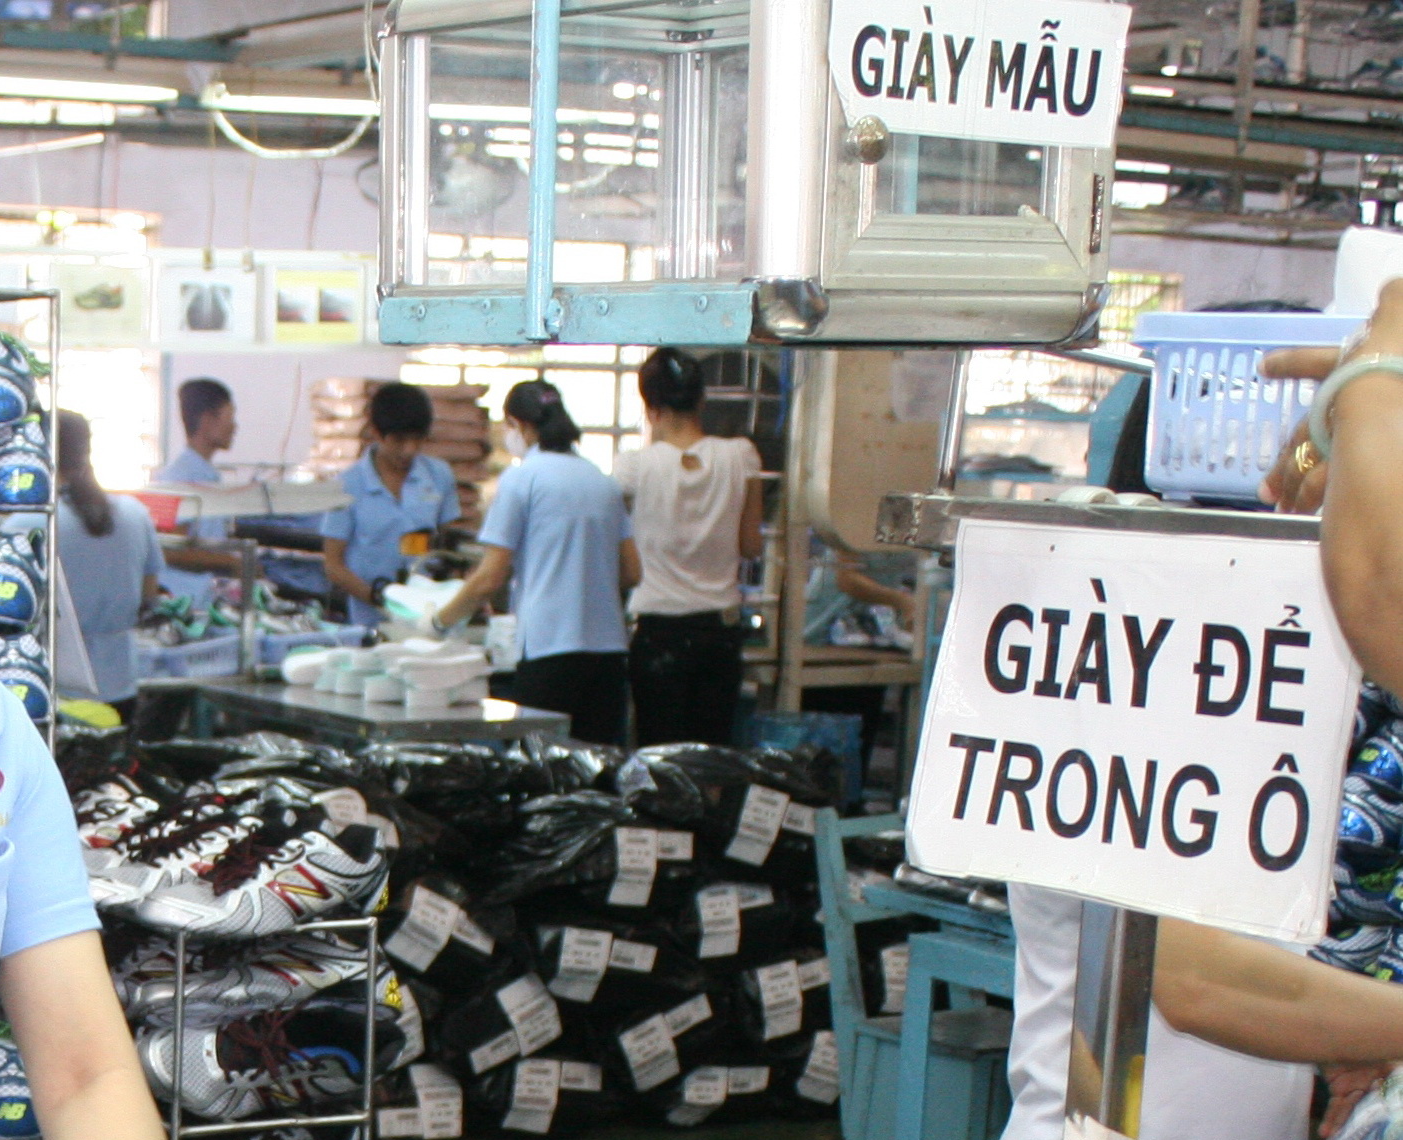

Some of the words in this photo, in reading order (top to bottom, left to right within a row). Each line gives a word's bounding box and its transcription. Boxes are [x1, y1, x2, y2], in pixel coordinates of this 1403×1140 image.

[852, 6, 974, 105] GIÀY
[985, 20, 1102, 116] MẪU
[984, 578, 1175, 708] GIÀY
[1193, 606, 1311, 726] ĐỂ
[949, 733, 1220, 857] TRONG
[1248, 753, 1310, 872] Ô
